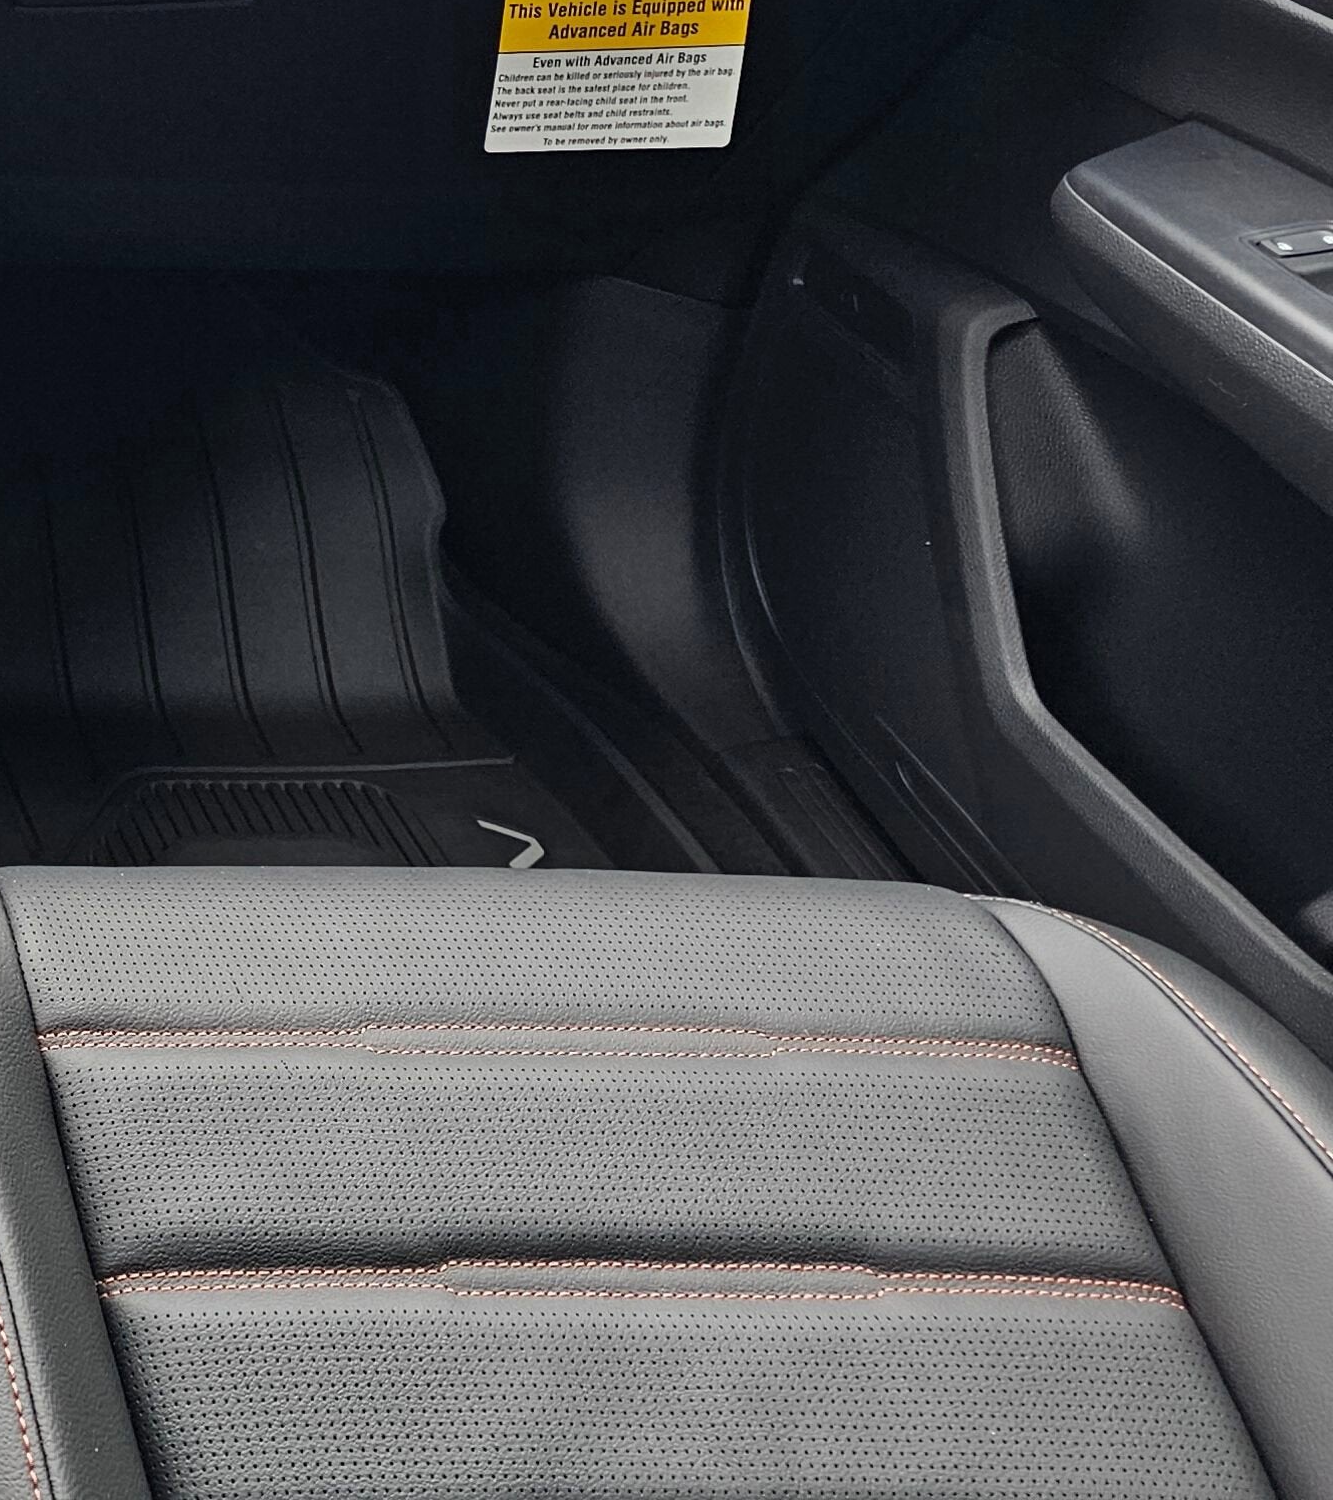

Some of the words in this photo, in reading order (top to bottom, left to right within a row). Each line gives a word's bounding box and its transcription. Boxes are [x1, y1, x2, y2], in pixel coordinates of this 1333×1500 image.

[509, 2, 543, 19] This
[548, 1, 608, 18] Vehicle
[612, 0, 627, 16] is
[548, 22, 626, 40] Advanced
[631, 22, 656, 37] Air
[660, 20, 699, 38] Bags
[532, 56, 562, 69] Even
[565, 55, 591, 68] with
[594, 53, 653, 67] Advanced
[656, 52, 675, 64] Air
[677, 51, 708, 65] Bags
[498, 74, 535, 83] Children
[536, 74, 552, 82] can
[554, 73, 565, 81] be
[566, 71, 591, 81] killed
[592, 72, 602, 80] or
[603, 70, 642, 80] seriously
[643, 69, 674, 79] injured
[675, 68, 686, 78] by
[687, 68, 702, 77] the
[703, 67, 716, 76] air
[497, 86, 513, 95] The
[514, 86, 535, 95] back
[537, 86, 556, 95] seat
[558, 85, 566, 94] is
[568, 85, 582, 94] the
[584, 84, 611, 93] safest
[611, 83, 636, 93] place
[638, 82, 651, 91] for
[652, 82, 691, 91] children.
[494, 99, 520, 108] Never
[522, 99, 537, 109] put
[545, 97, 594, 107] rear-facing
[595, 97, 617, 106] child
[619, 97, 638, 105] seat
[639, 96, 648, 104] in
[650, 95, 664, 104] the
[493, 112, 523, 122] Always
[525, 112, 541, 120] use
[543, 111, 562, 120] seat
[563, 110, 585, 119] belts
[587, 109, 604, 118] and
[605, 108, 627, 118] child
[490, 124, 507, 133] See
[508, 124, 542, 133] owner's
[543, 123, 575, 132] manual
[577, 122, 590, 131] for
[591, 122, 613, 130] more
[614, 120, 664, 130] information
[665, 119, 689, 129] about
[690, 119, 703, 127] air
[543, 137, 553, 146] To
[555, 137, 566, 146] be
[568, 136, 606, 146] removed
[607, 136, 618, 146] by
[620, 136, 648, 144] owner
